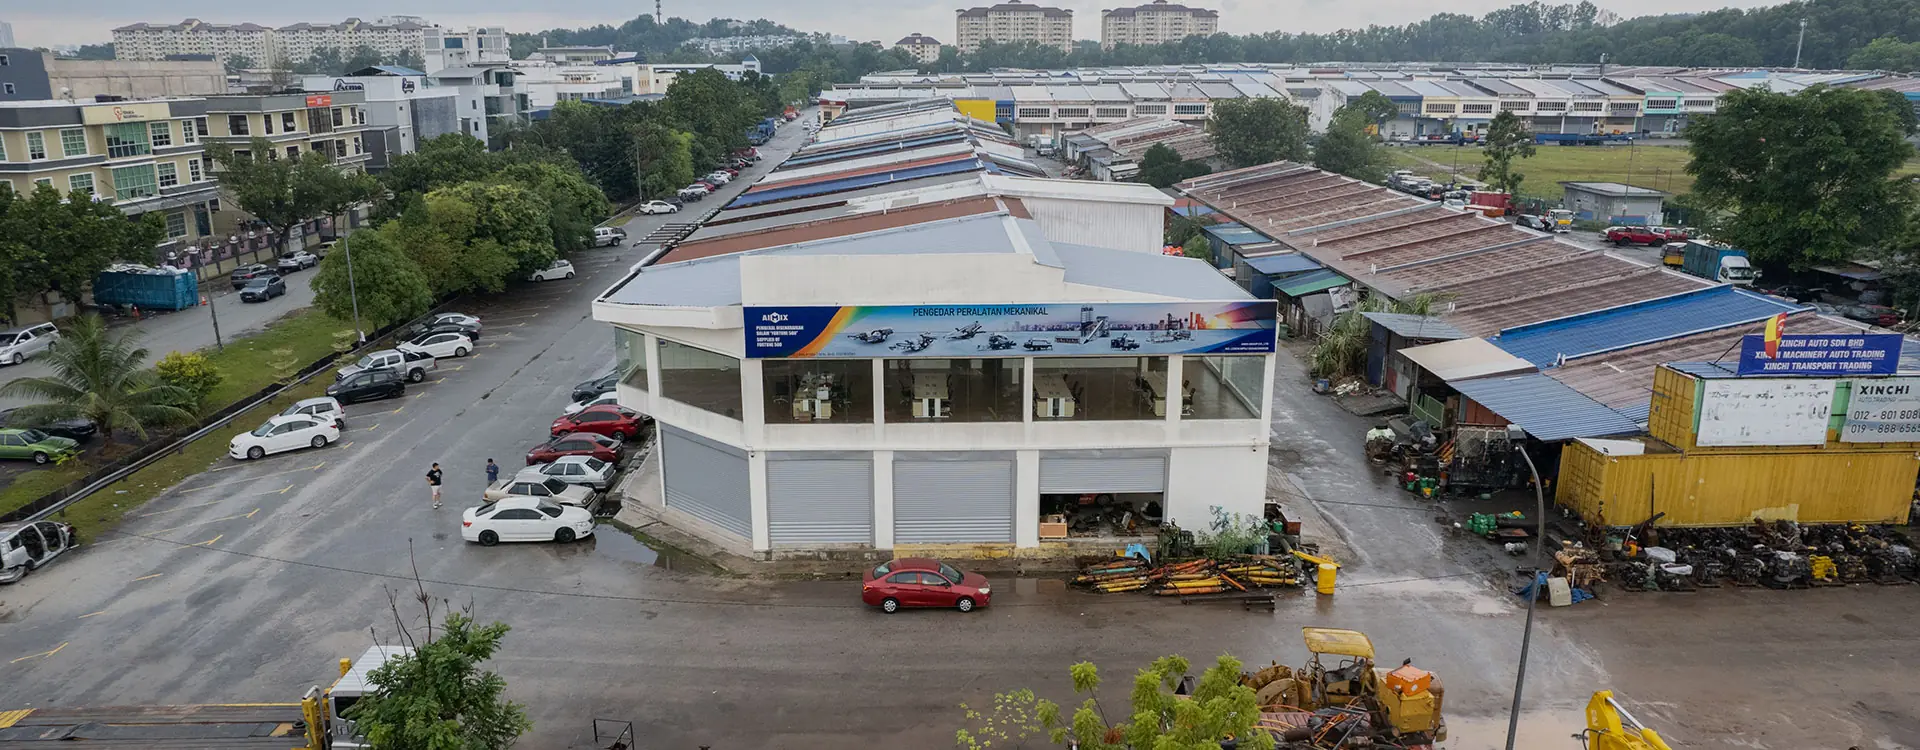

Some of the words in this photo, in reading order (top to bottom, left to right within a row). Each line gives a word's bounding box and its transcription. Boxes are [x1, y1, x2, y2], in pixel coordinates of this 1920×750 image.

[913, 308, 955, 316] PENGEDAR
[957, 308, 1002, 316] PERALATAN
[1003, 307, 1049, 315] MEKANIKAL
[1780, 339, 1806, 347] XINCHI
[1808, 339, 1828, 347] AUTO
[1830, 339, 1846, 347] SDN
[1847, 339, 1864, 347] BHD
[1829, 350, 1849, 358] AUTO
[1852, 350, 1885, 358] TRADING
[1764, 362, 1789, 370] XINCHI
[1792, 362, 1837, 370] TRANSPORT
[1839, 362, 1872, 370] TRADING
[1859, 385, 1910, 395] XINCHI
[1853, 411, 1870, 420] 012
[1880, 410, 1897, 420] 801
[1899, 410, 1920, 420] 808
[1850, 424, 1867, 433] 019
[1877, 424, 1897, 433] 888
